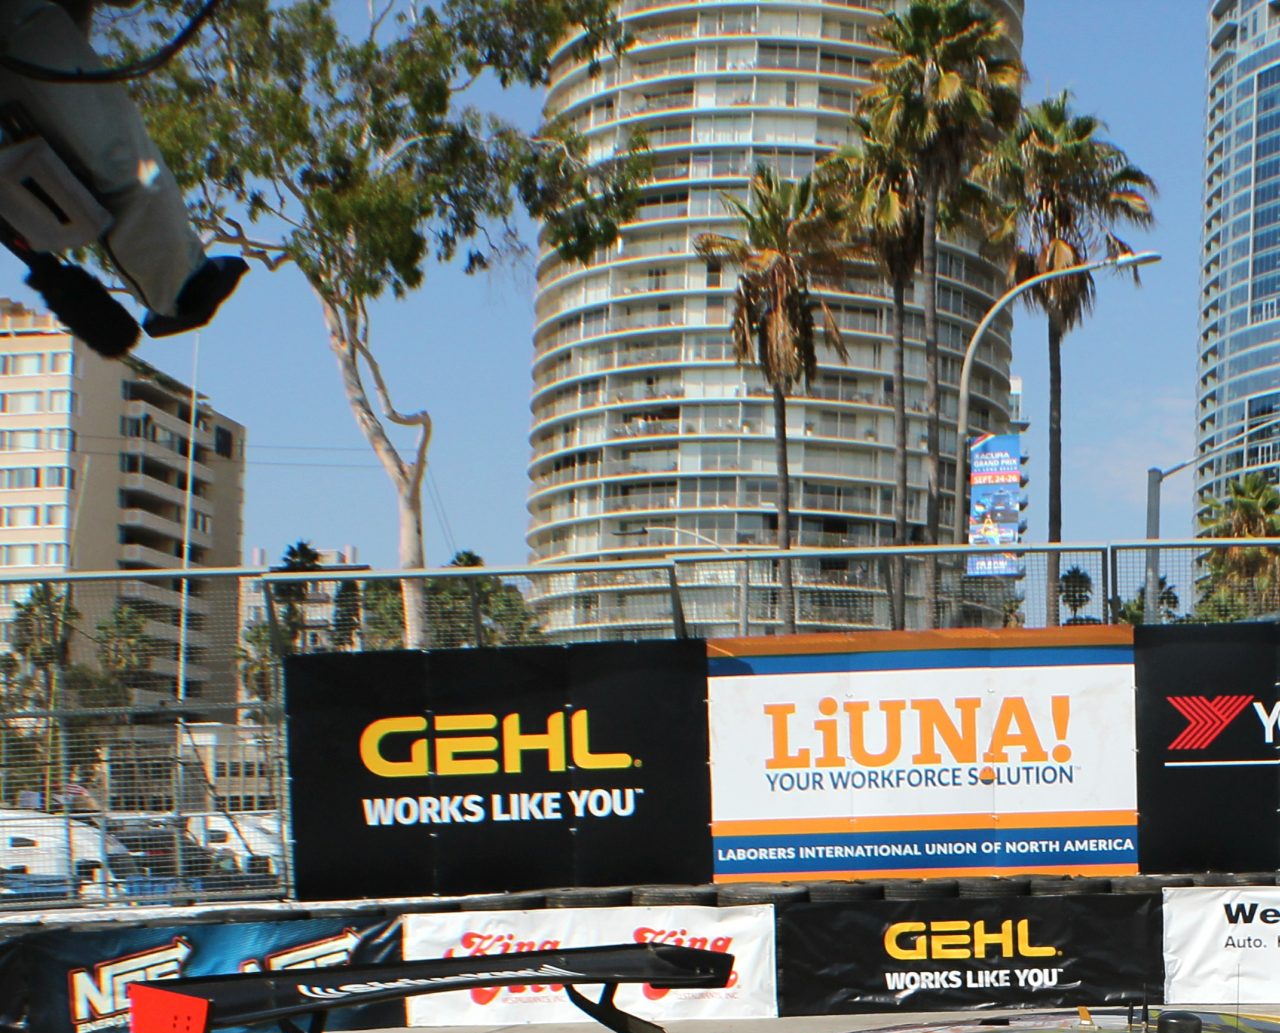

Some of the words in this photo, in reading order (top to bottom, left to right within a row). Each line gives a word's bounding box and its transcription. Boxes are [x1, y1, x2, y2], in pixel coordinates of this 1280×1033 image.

[359, 708, 634, 778] GEHL
[764, 696, 1073, 769] LiUNA!
[766, 771, 824, 792] YOUR
[831, 768, 962, 791] WORKFORCE
[363, 794, 486, 827] WORKS
[492, 791, 562, 822] LIKE
[568, 789, 637, 818] YOU
[717, 847, 795, 861] LABORERS
[799, 844, 921, 860] INTERNATIONAL
[925, 842, 977, 855] UNION
[981, 841, 1002, 854] OF
[1005, 840, 1060, 854] NORTH
[1063, 838, 1135, 852] AMERICA
[884, 918, 1057, 961] GEHL
[1224, 935, 1267, 949] Auto.
[885, 970, 962, 991] WORKS
[966, 969, 1013, 990] LIKE
[1014, 968, 1059, 988] YOU
